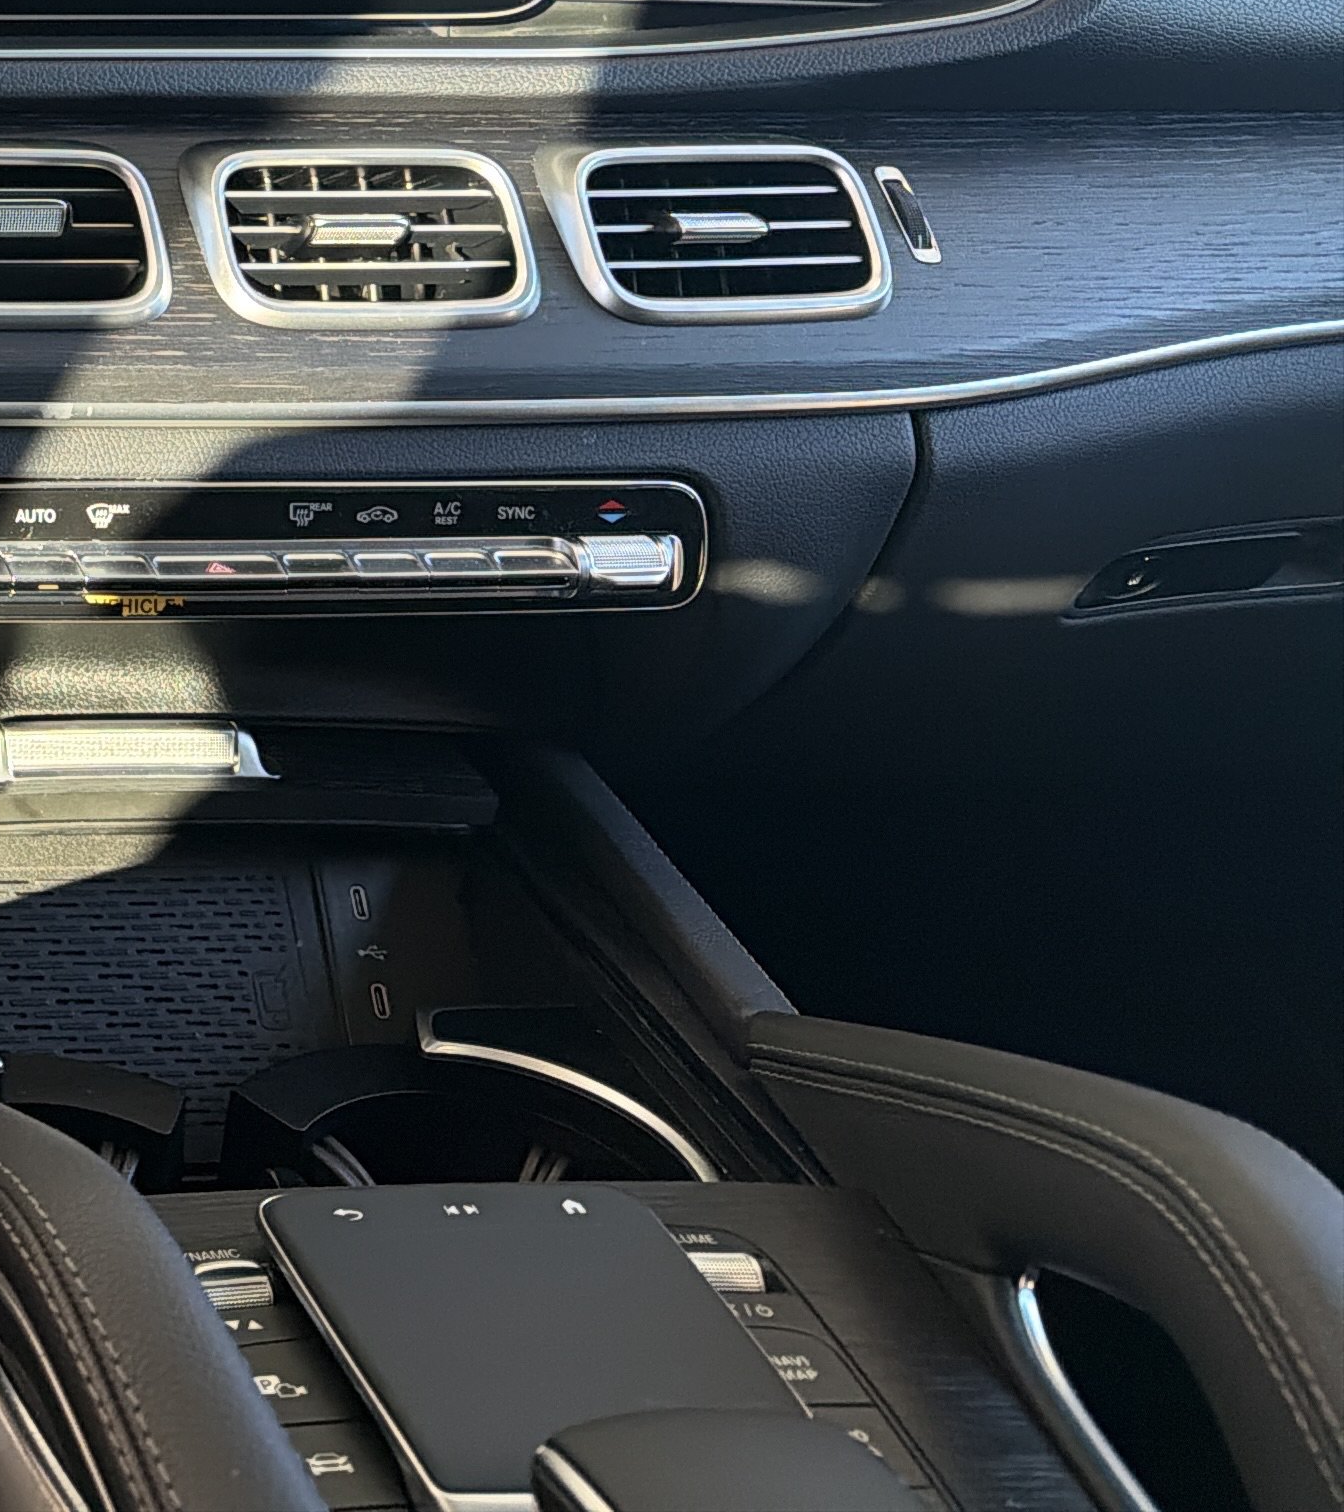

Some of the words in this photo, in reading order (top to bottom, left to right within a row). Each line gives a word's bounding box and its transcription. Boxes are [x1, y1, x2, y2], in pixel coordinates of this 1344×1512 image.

[109, 504, 130, 514] MAX
[309, 502, 332, 512] REAR
[433, 501, 461, 516] A/C
[497, 506, 536, 520] SYNC
[14, 508, 57, 524] AUTO
[434, 516, 458, 526] REST
[769, 1354, 811, 1367] NAVI
